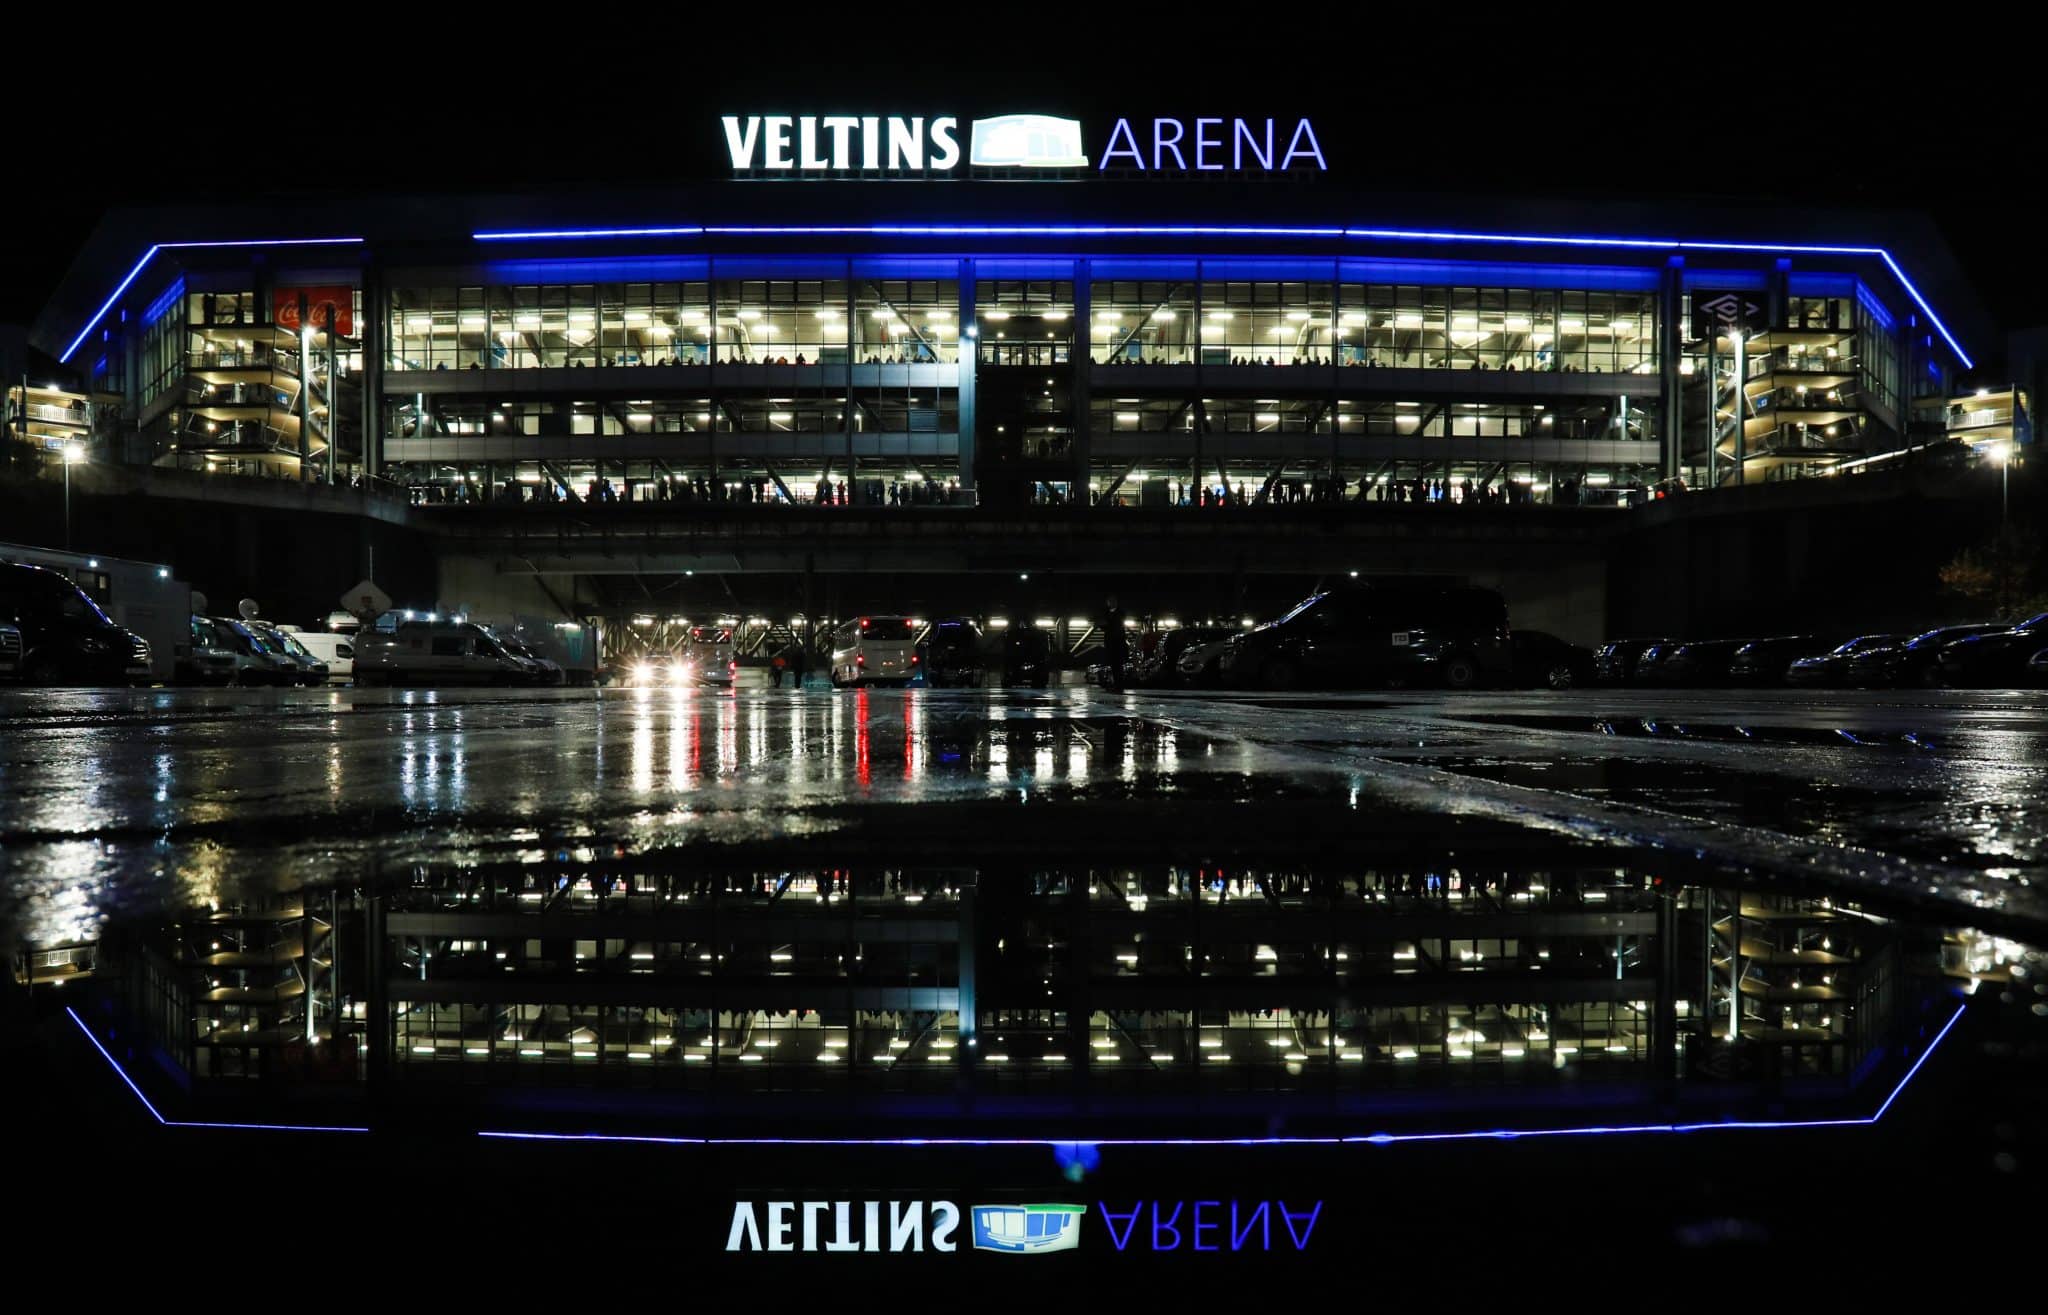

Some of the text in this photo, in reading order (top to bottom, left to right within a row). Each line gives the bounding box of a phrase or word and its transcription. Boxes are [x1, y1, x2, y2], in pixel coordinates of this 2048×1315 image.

[721, 116, 1327, 170] VELTINS ARENA
[279, 299, 343, 324] Coc-Coa
